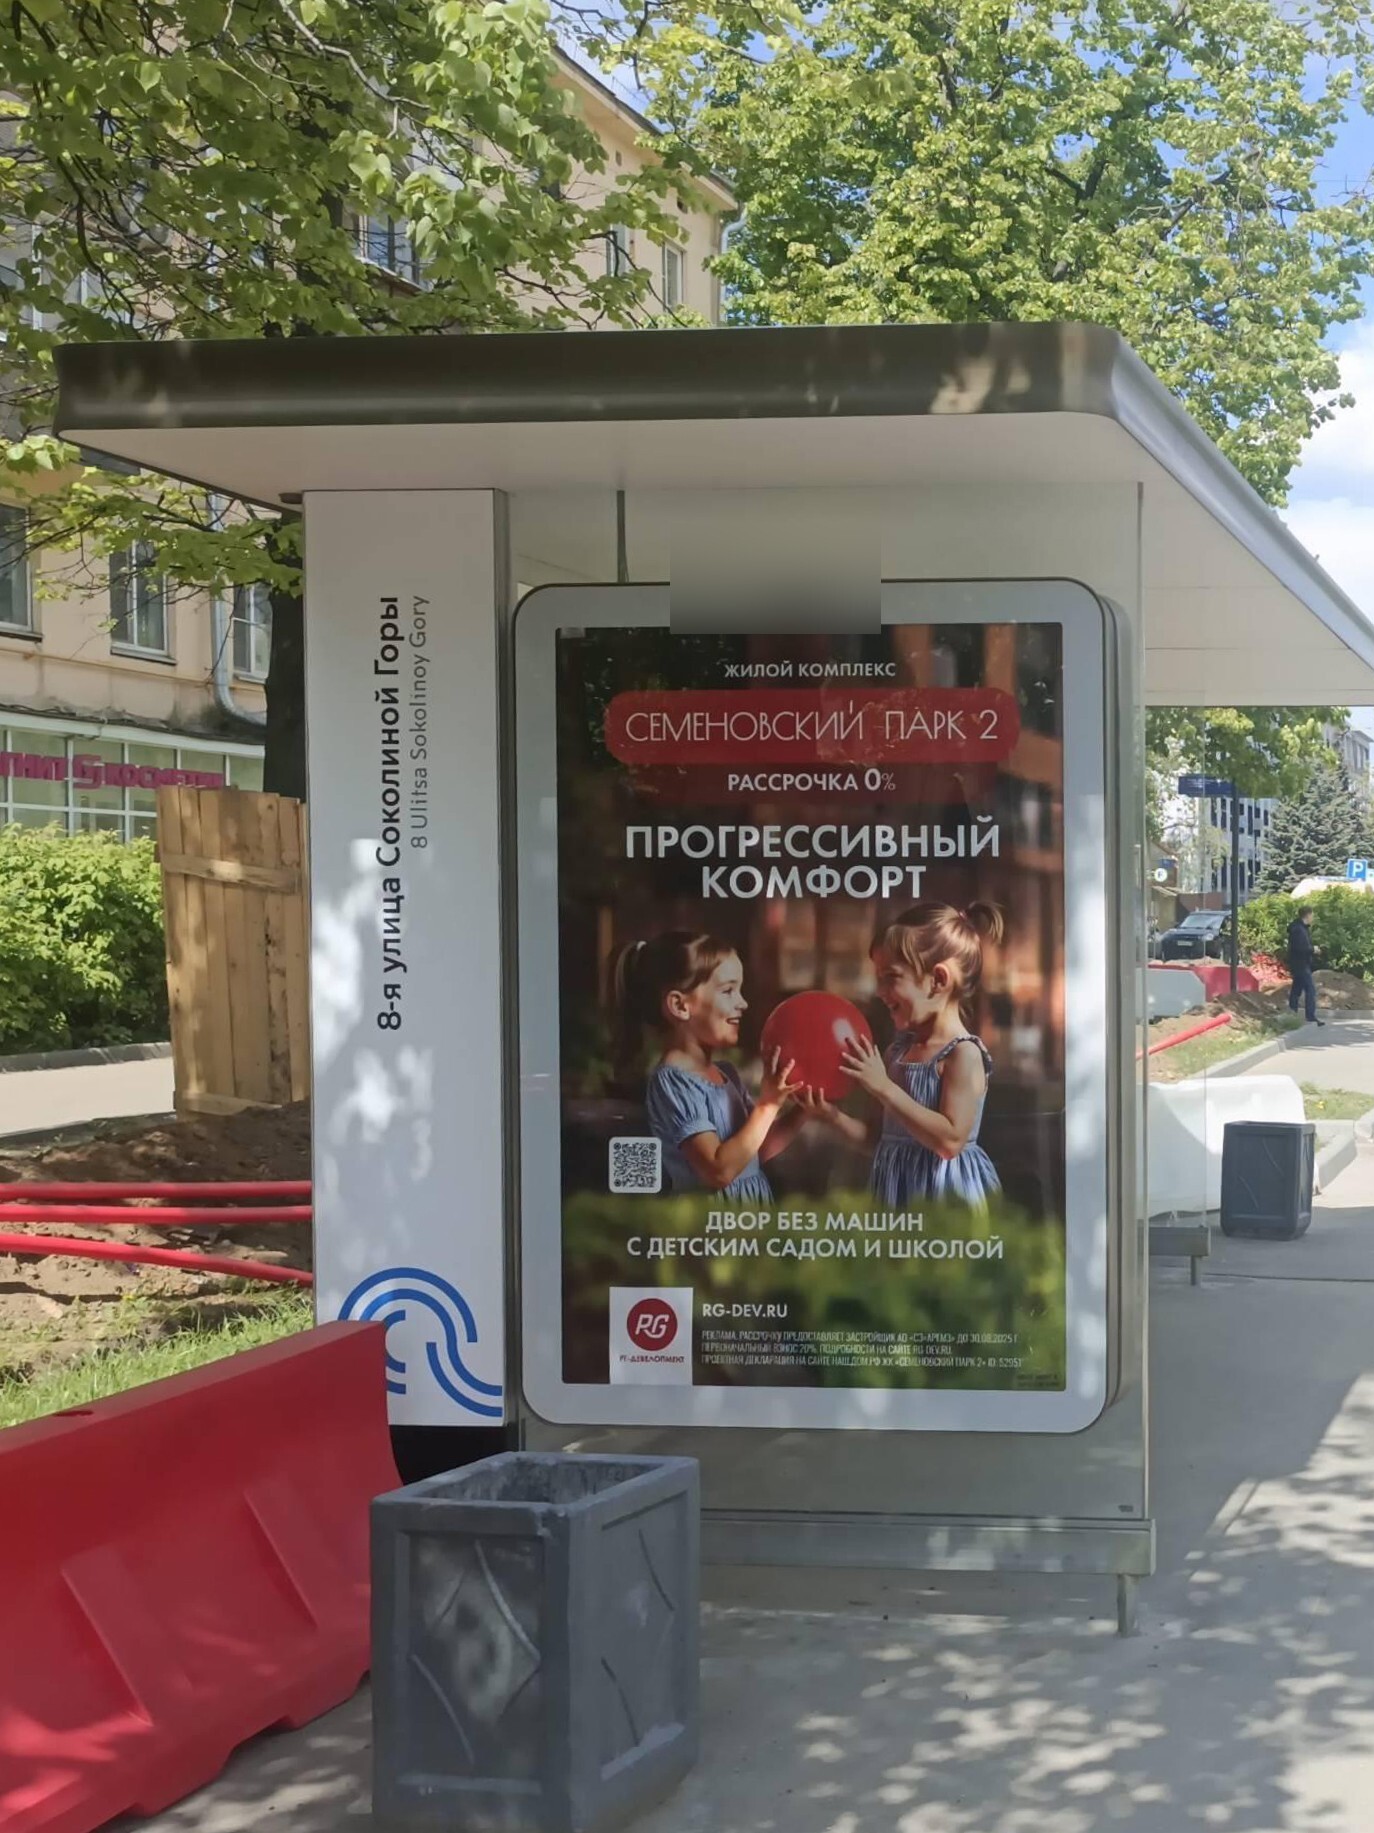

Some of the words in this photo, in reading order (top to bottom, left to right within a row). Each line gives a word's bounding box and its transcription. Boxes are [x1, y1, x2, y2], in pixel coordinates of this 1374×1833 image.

[374, 597, 405, 675] Горы
[409, 595, 430, 648] Gory
[724, 660, 793, 678] ЖИЛОЙ
[798, 662, 897, 678] КОМПЛЕКС
[409, 654, 430, 761] Sokolinoy
[625, 701, 863, 742] СЕМЕНОВСКИЙ
[885, 709, 967, 740] ПАРК
[979, 709, 999, 740] 2
[375, 689, 402, 868] Соколиной
[410, 767, 428, 828] Ulitsa
[727, 772, 859, 792] РАССРОЧКА
[864, 768, 897, 792] 0%
[411, 836, 428, 850] 8
[625, 815, 1000, 859] ПРОГРЕССИВНЫЙ
[701, 865, 927, 899] КОМФОРТ
[382, 877, 407, 974] улица
[377, 983, 402, 1031] 8-я
[705, 1211, 771, 1234] ДВОР
[778, 1212, 818, 1231] БЕЗ
[824, 1212, 924, 1232] МАШИН
[626, 1237, 641, 1257] С
[647, 1237, 760, 1259] ДЕТСКИМ
[766, 1238, 857, 1260] САДОМ
[863, 1239, 881, 1258] И
[888, 1235, 1004, 1260] ШКОЛОЙ
[635, 1314, 669, 1338] RG
[702, 1303, 788, 1318] RG-DEV.RU
